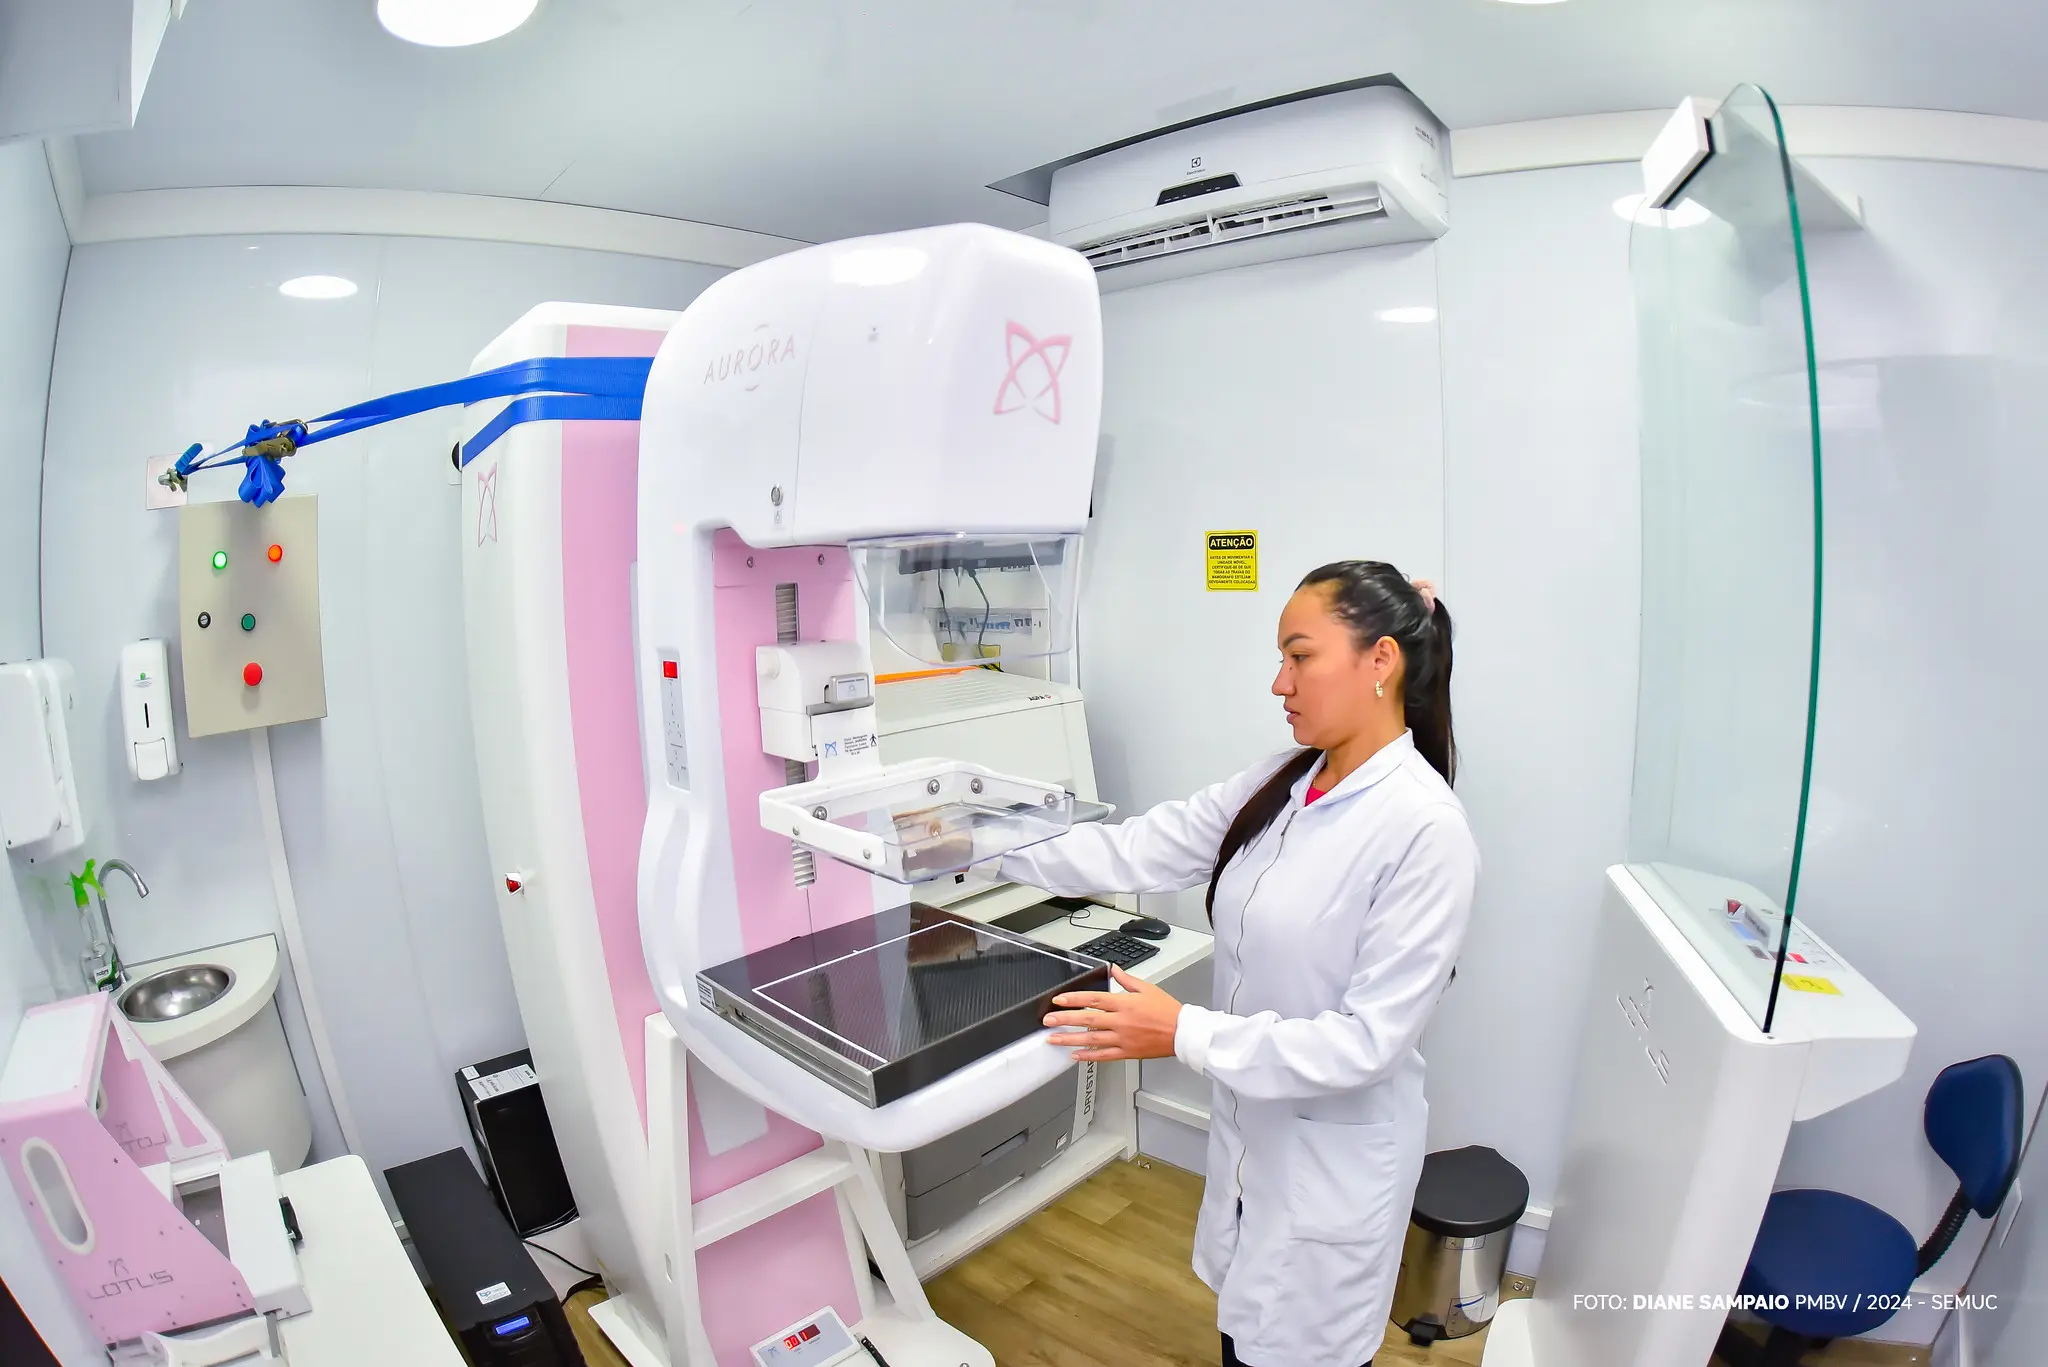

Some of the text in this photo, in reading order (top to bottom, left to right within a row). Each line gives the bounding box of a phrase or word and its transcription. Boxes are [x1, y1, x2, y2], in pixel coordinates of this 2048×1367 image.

[703, 334, 795, 385] AURORA
[1210, 537, 1253, 548] ATENÇÃO
[85, 1270, 174, 1300] LOTUS
